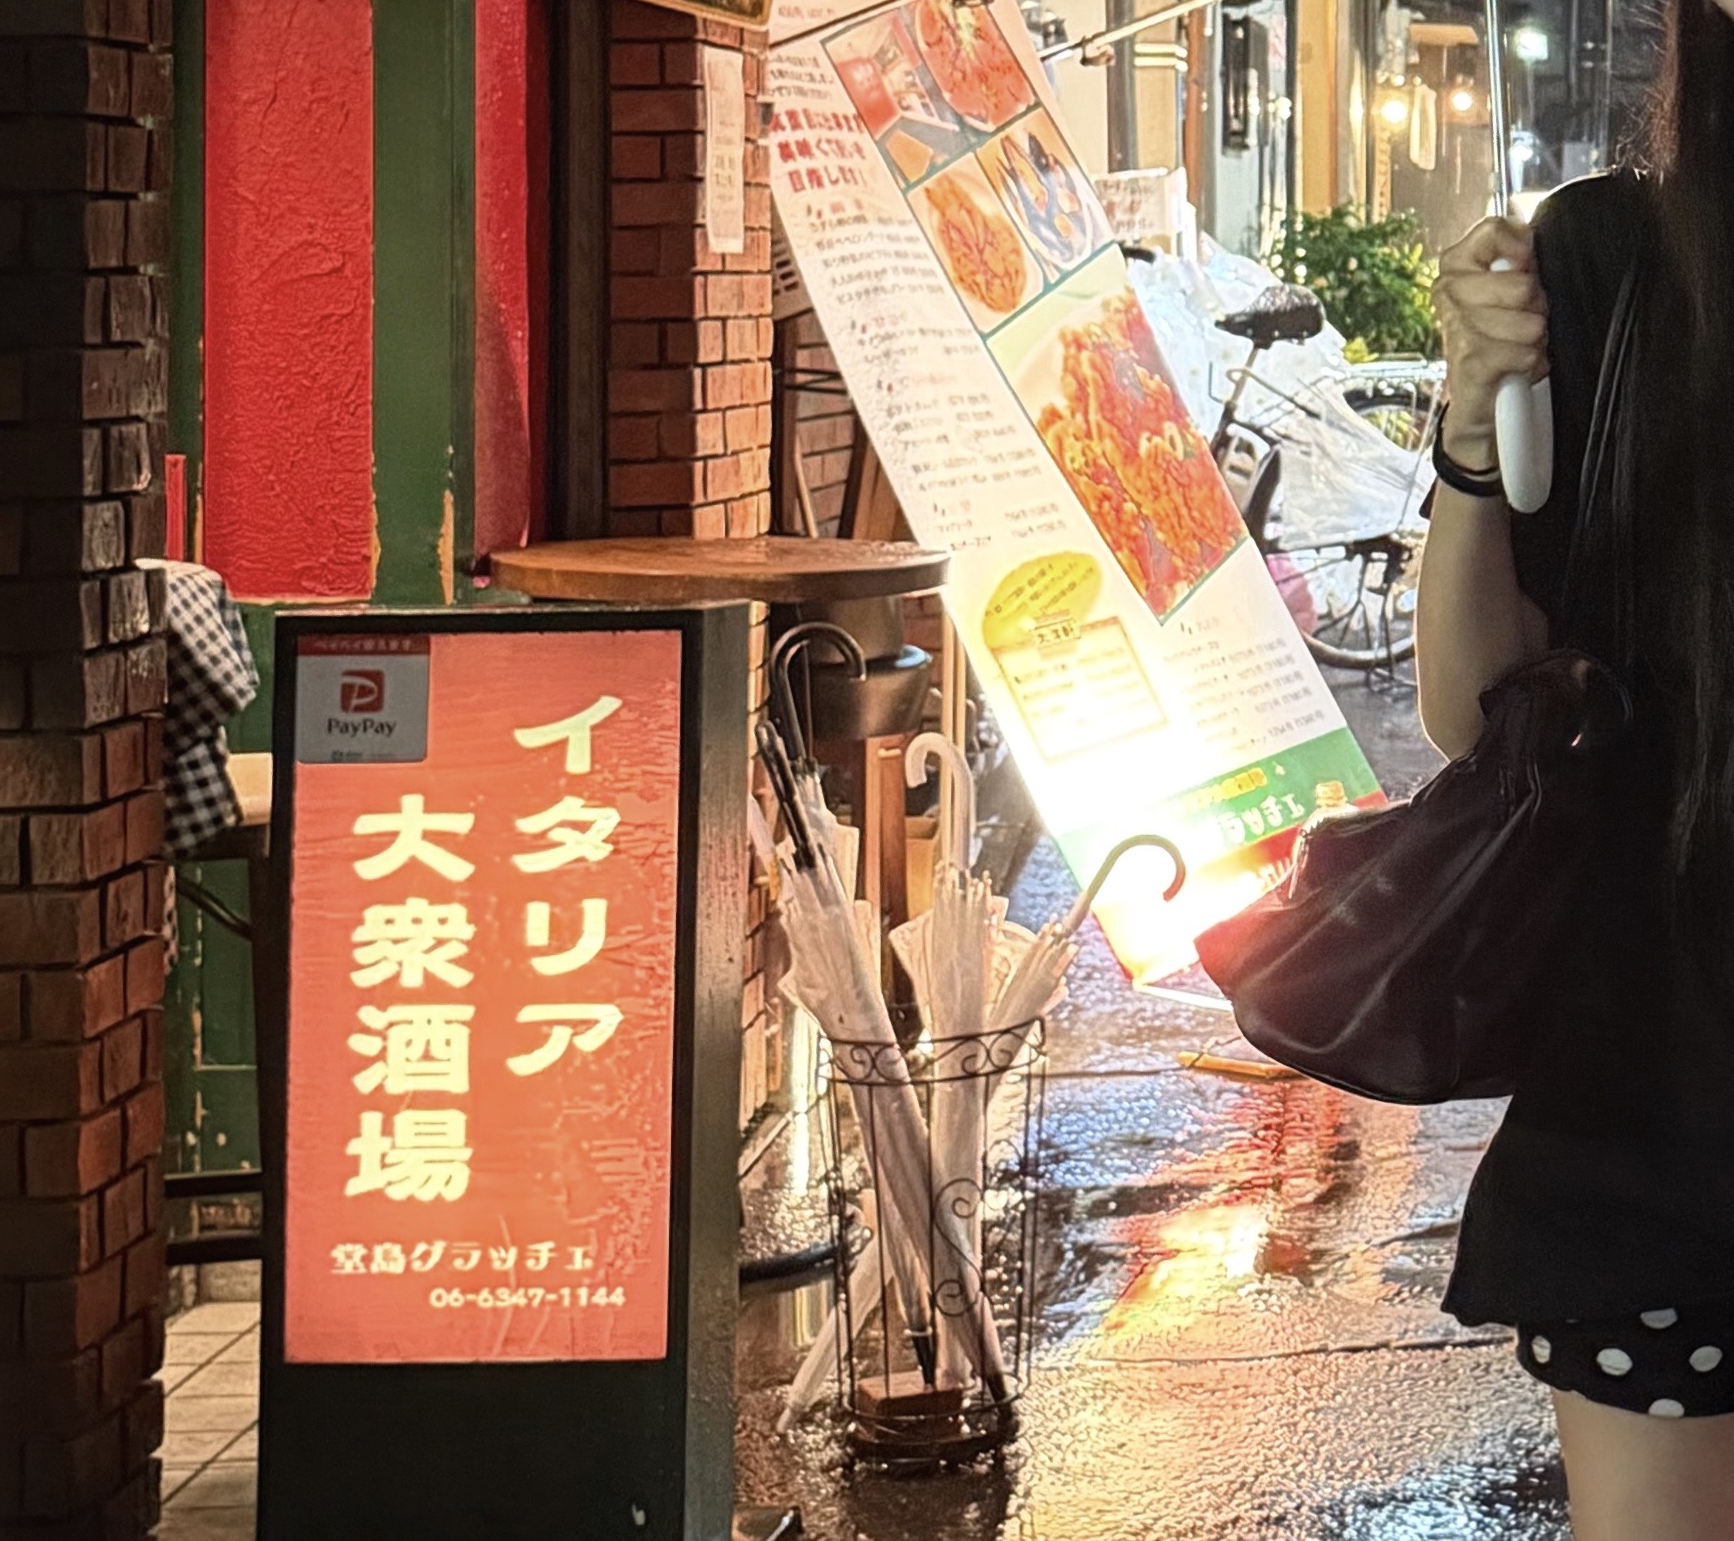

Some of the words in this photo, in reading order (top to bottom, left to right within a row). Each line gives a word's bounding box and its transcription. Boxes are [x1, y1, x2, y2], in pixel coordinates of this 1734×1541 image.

[326, 717, 398, 738] PayPay
[506, 695, 625, 1077] イタリア
[344, 794, 476, 1202] 大衆酒場
[330, 1239, 595, 1275] 堂島グラッチェ
[429, 1286, 626, 1308] 06-6347-1144
